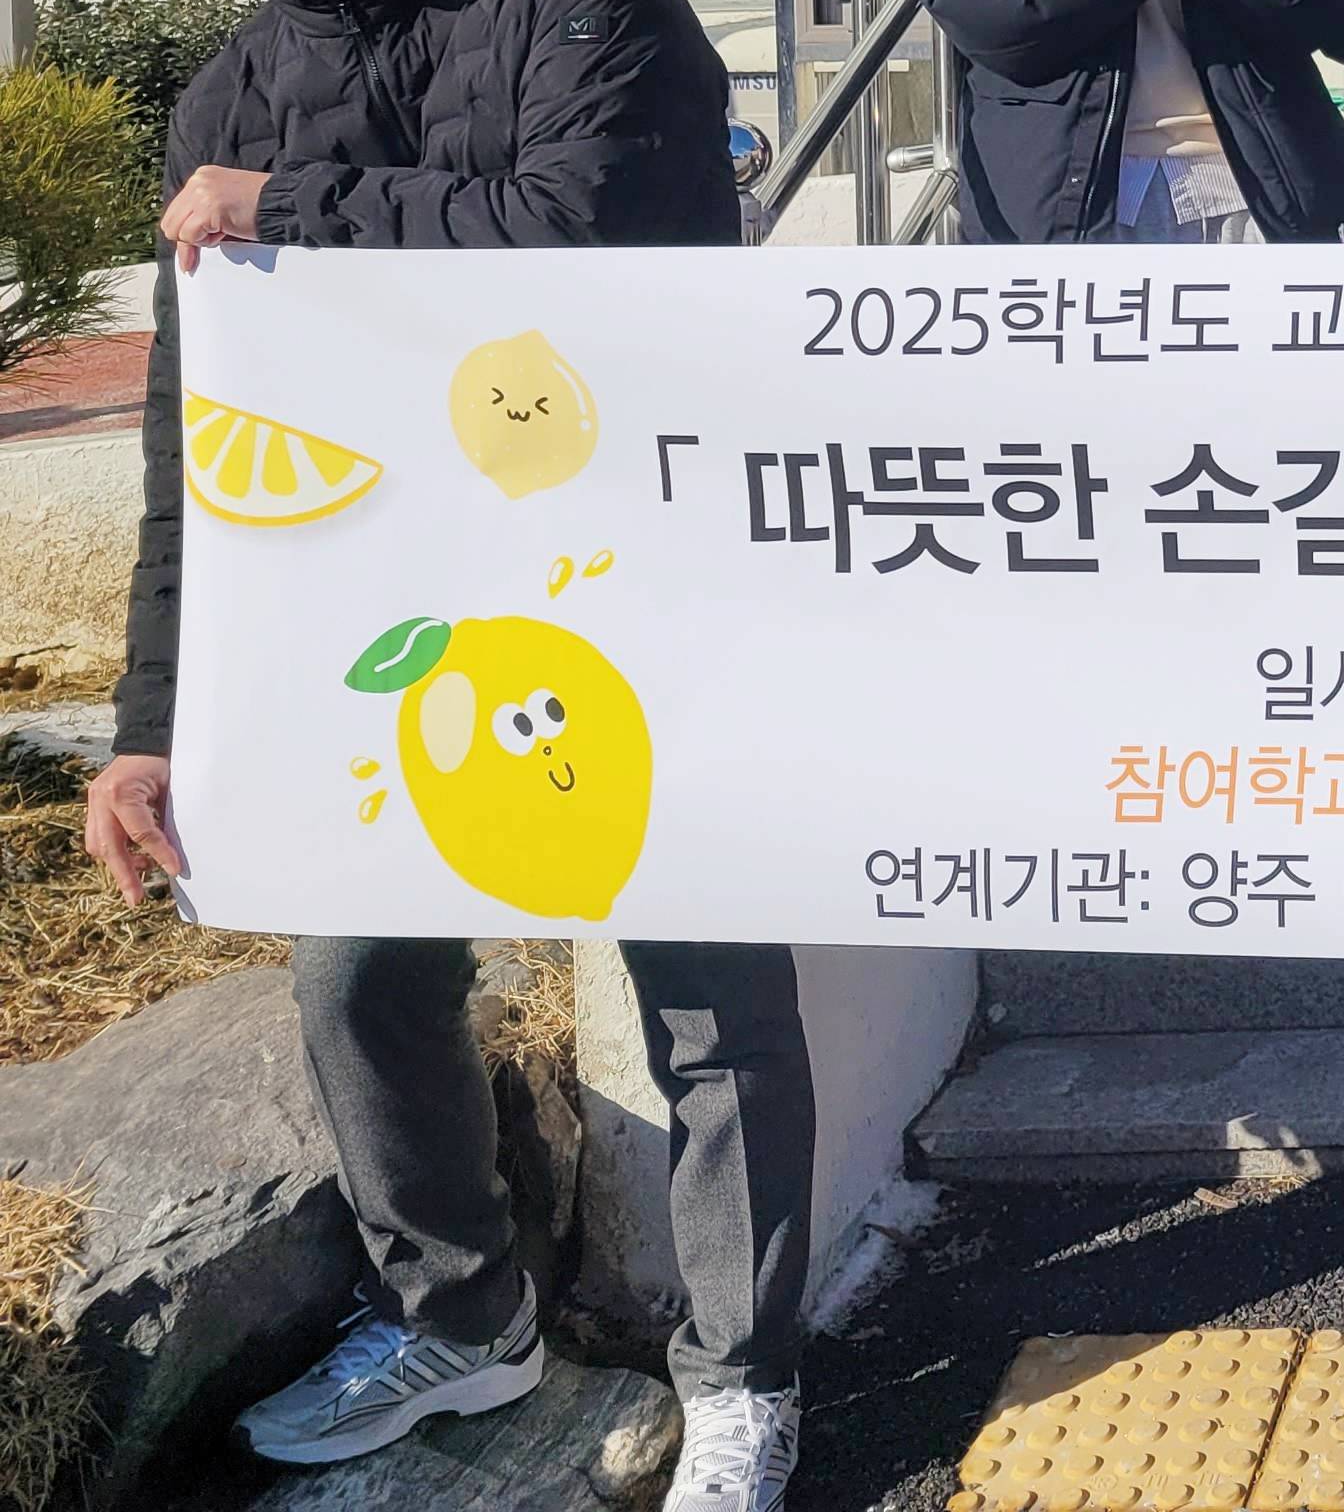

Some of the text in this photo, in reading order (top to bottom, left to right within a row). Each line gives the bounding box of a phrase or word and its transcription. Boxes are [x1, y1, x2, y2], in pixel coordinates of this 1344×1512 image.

[803, 276, 1240, 365] 2025학년도
[743, 443, 1109, 575] 따뜻한
[864, 847, 1151, 924] 연계기관:
[1180, 850, 1317, 929] 양주
